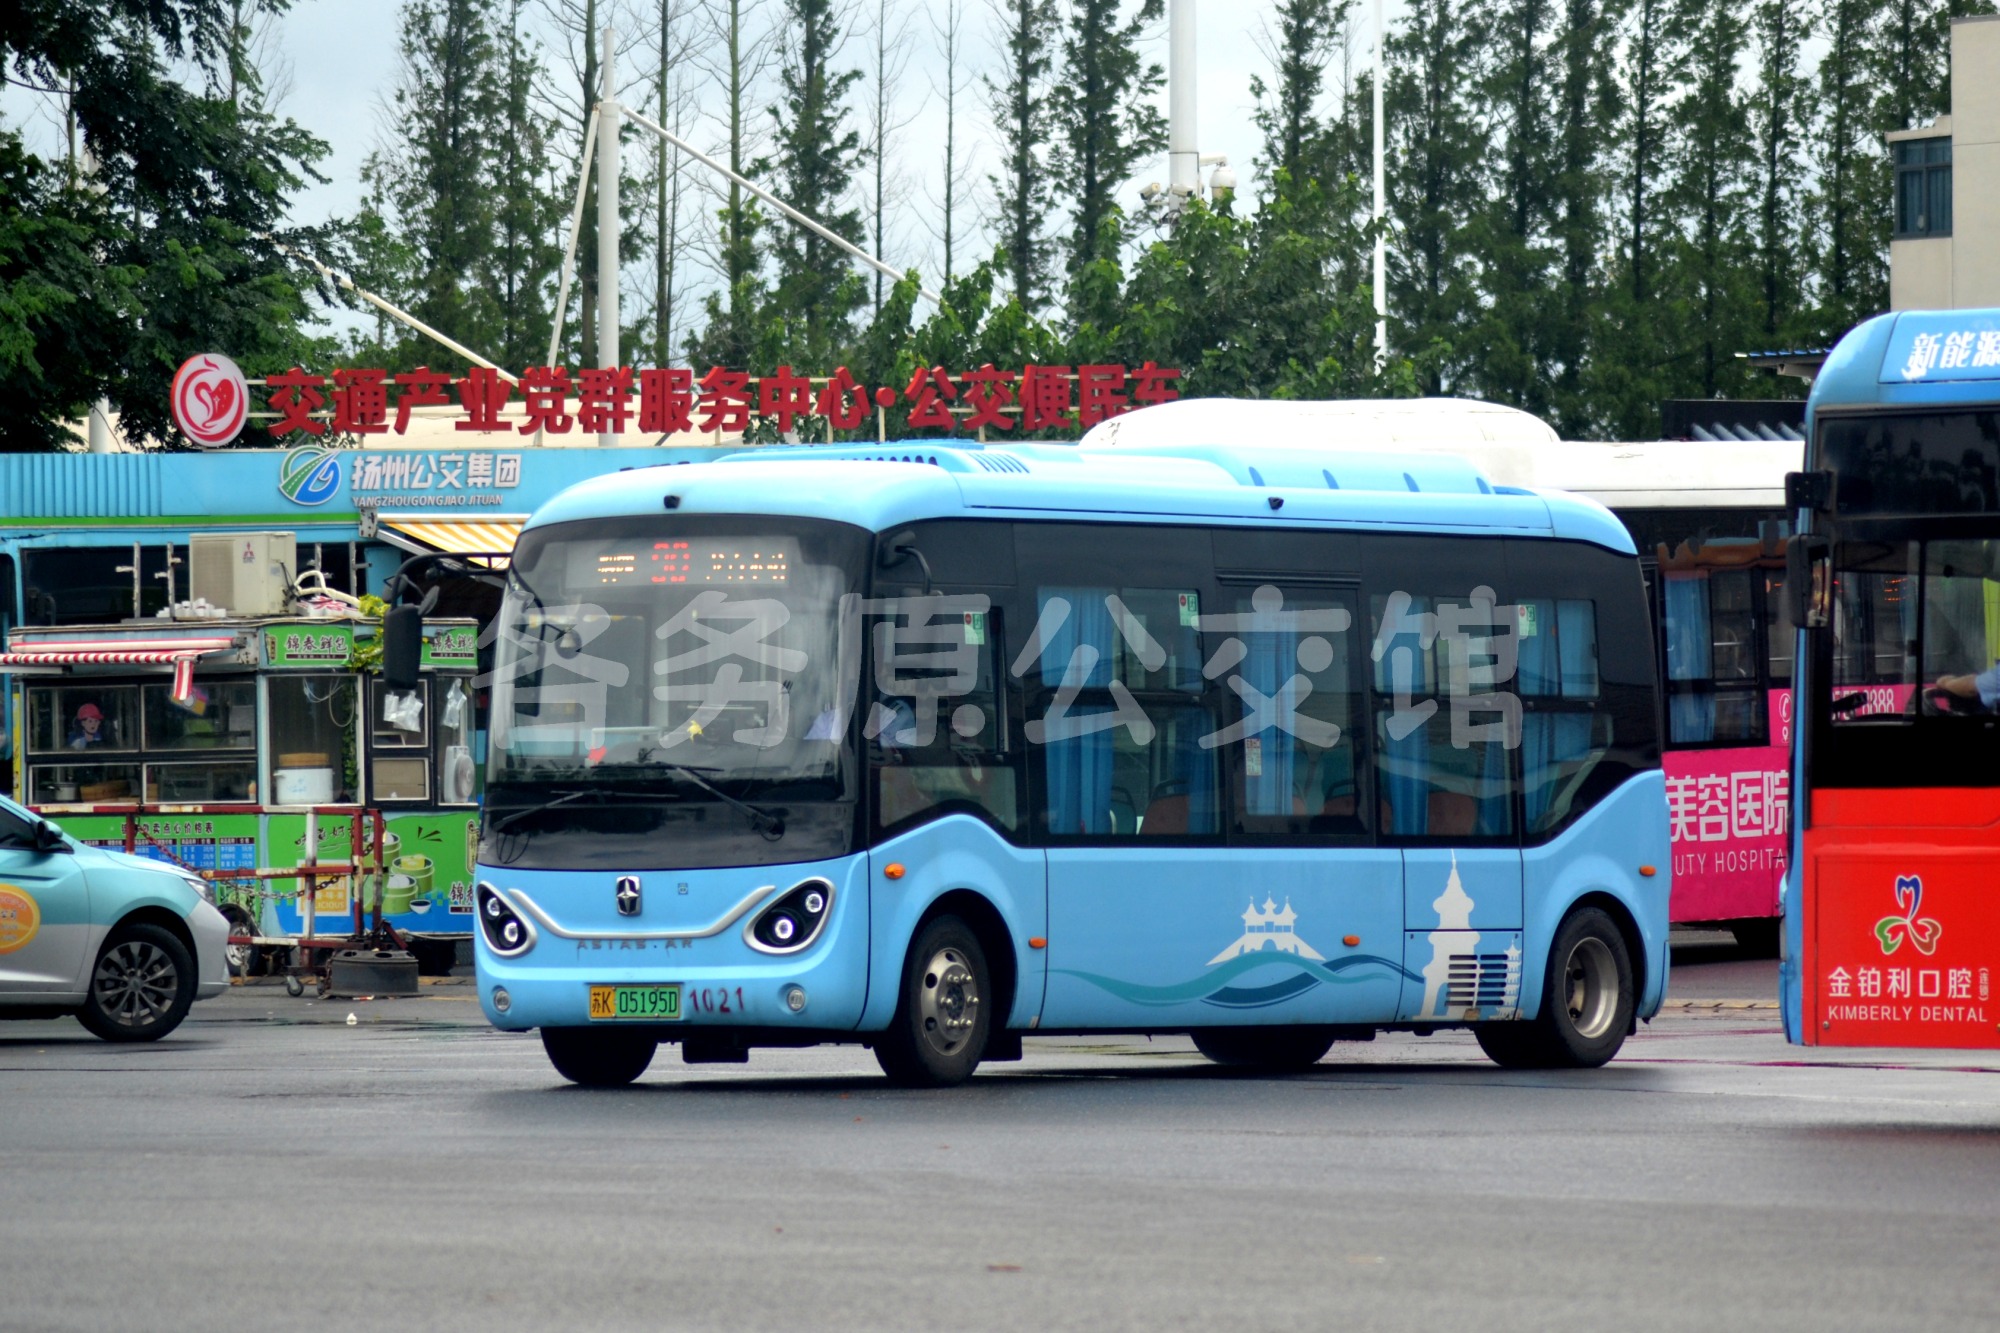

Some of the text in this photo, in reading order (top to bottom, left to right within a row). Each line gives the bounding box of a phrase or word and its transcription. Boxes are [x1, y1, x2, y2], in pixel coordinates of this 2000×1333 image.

[352, 453, 522, 490] 扬州公交集团
[352, 495, 503, 507] YANGZHOUGONGJIAO JITUAN
[1665, 769, 1789, 842] 美容医院
[1671, 848, 1786, 876] UTY HOSPITA
[1828, 966, 1972, 999] 金铂利口腔
[689, 986, 744, 1014] 1021
[1828, 1005, 1988, 1022] KIMBERLY DENTAL
